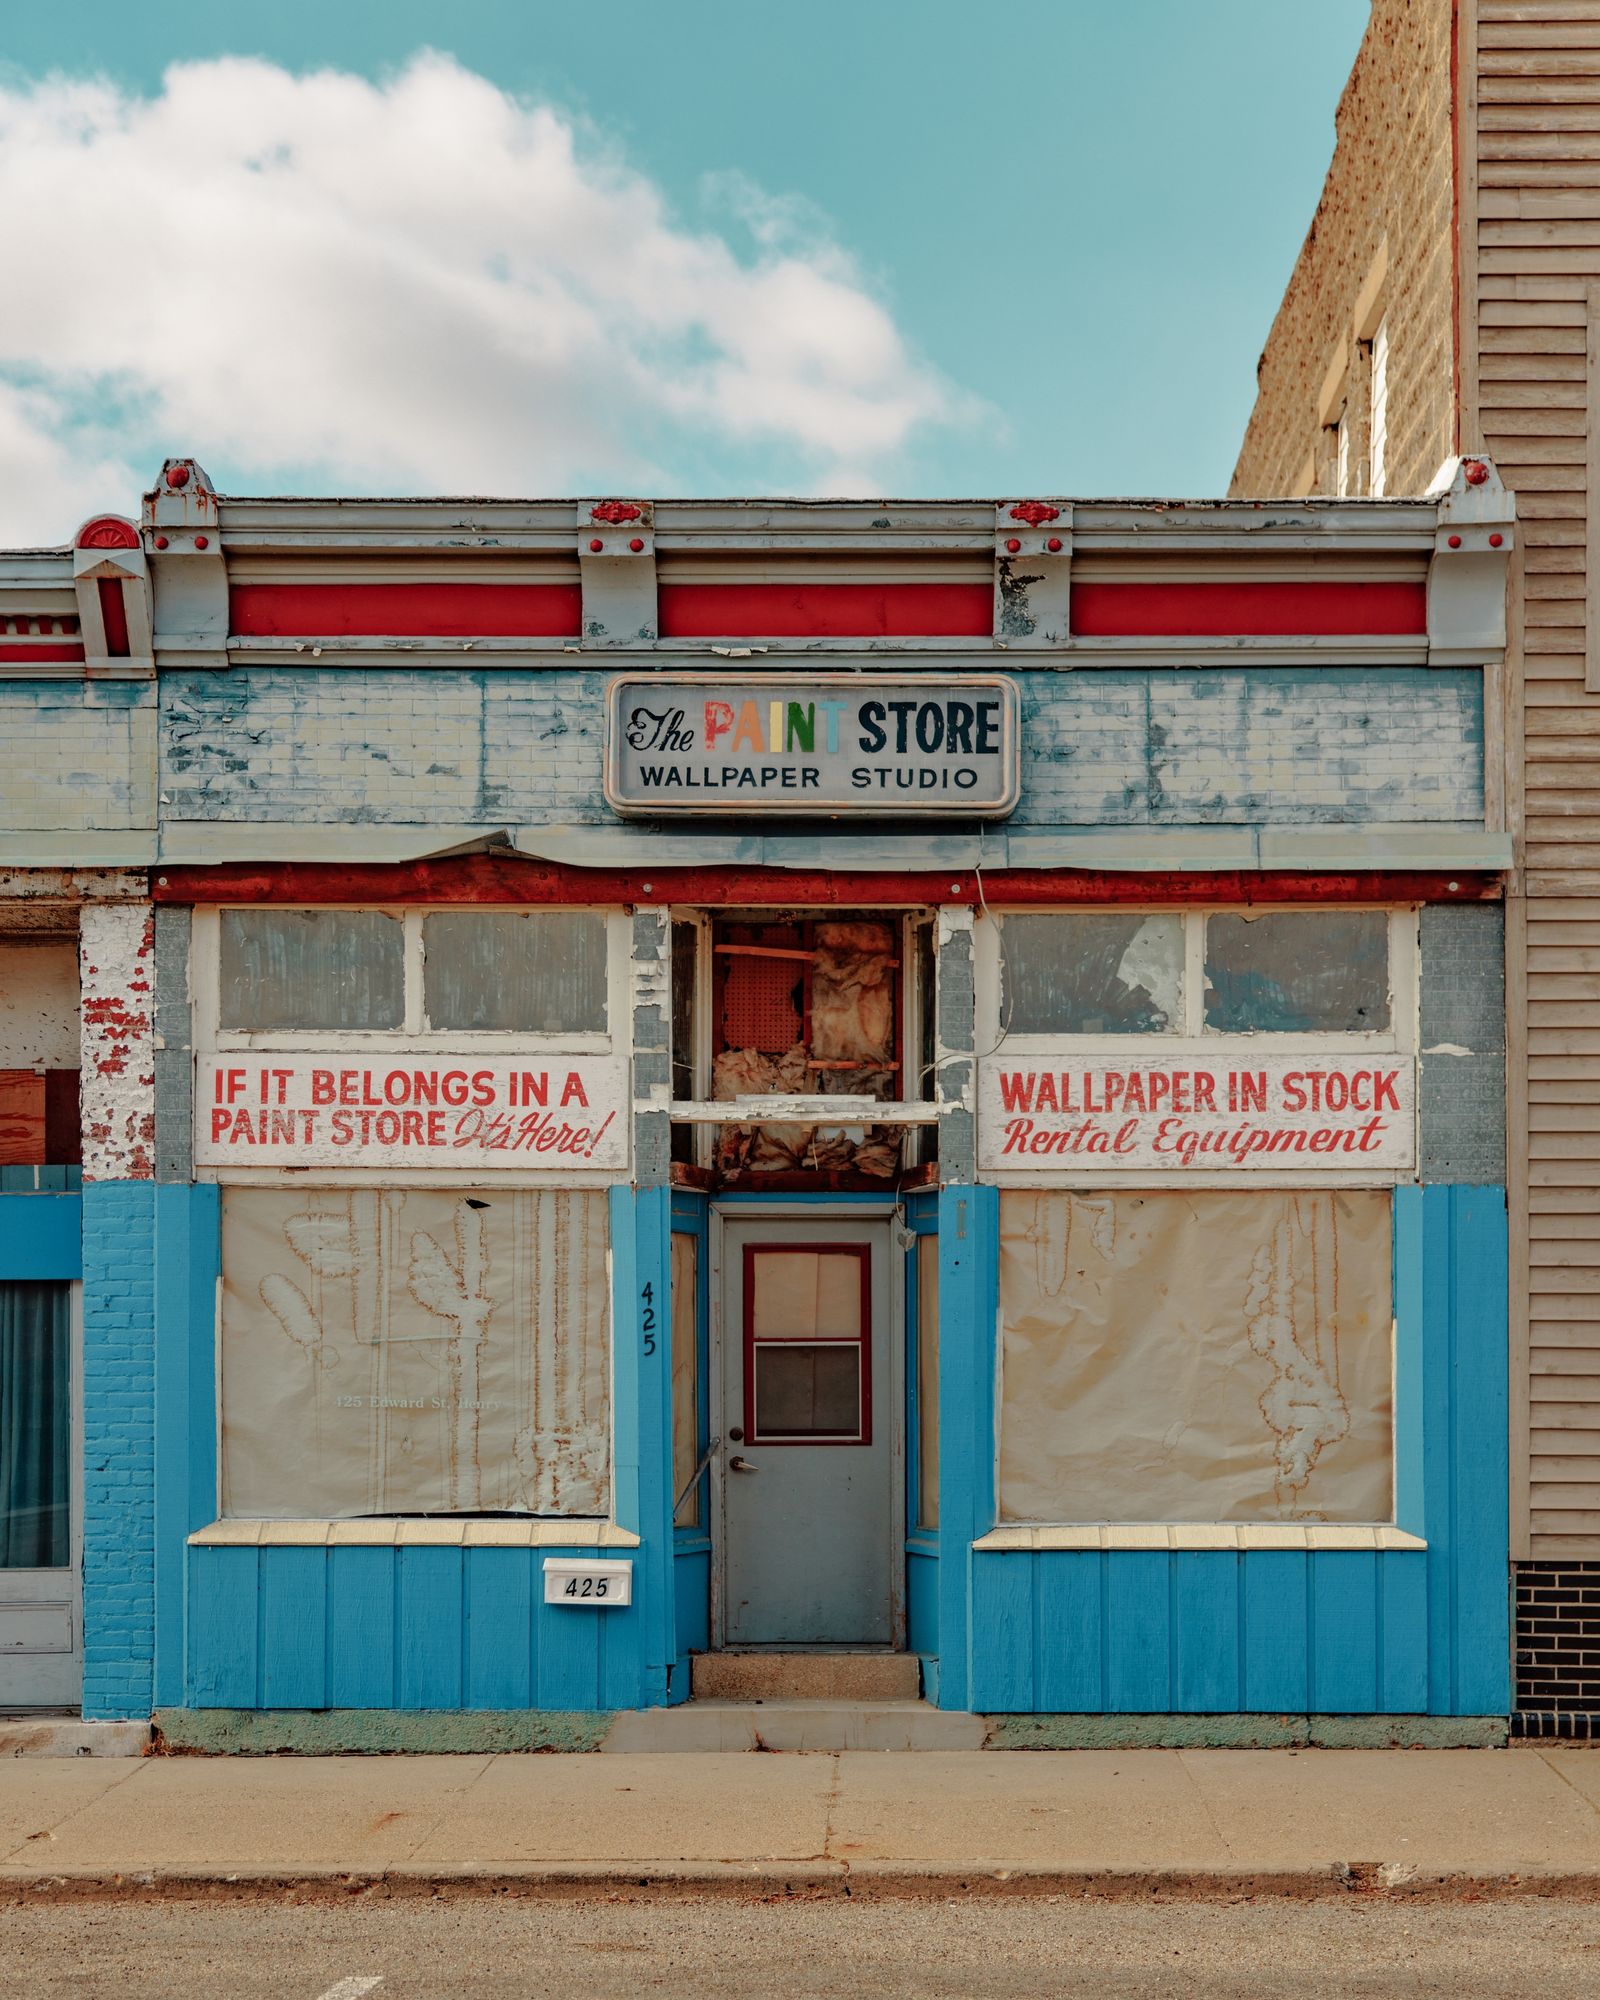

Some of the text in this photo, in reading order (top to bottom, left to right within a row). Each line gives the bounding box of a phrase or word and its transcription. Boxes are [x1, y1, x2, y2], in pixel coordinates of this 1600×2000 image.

[625, 701, 999, 754] The PAINT STORE
[640, 766, 978, 789] WALLPAPER STUDIO
[215, 1069, 590, 1108] IF IT BELONGS IN A
[1000, 1070, 1401, 1113] WALLPAPER IN STOCK
[211, 1108, 320, 1145] PAINT
[331, 1110, 446, 1146] STORE
[505, 1110, 617, 1158] Here!
[1001, 1116, 1389, 1166] Rental Equipment
[370, 1396, 424, 1409] Edward
[565, 1577, 608, 1597] 425
